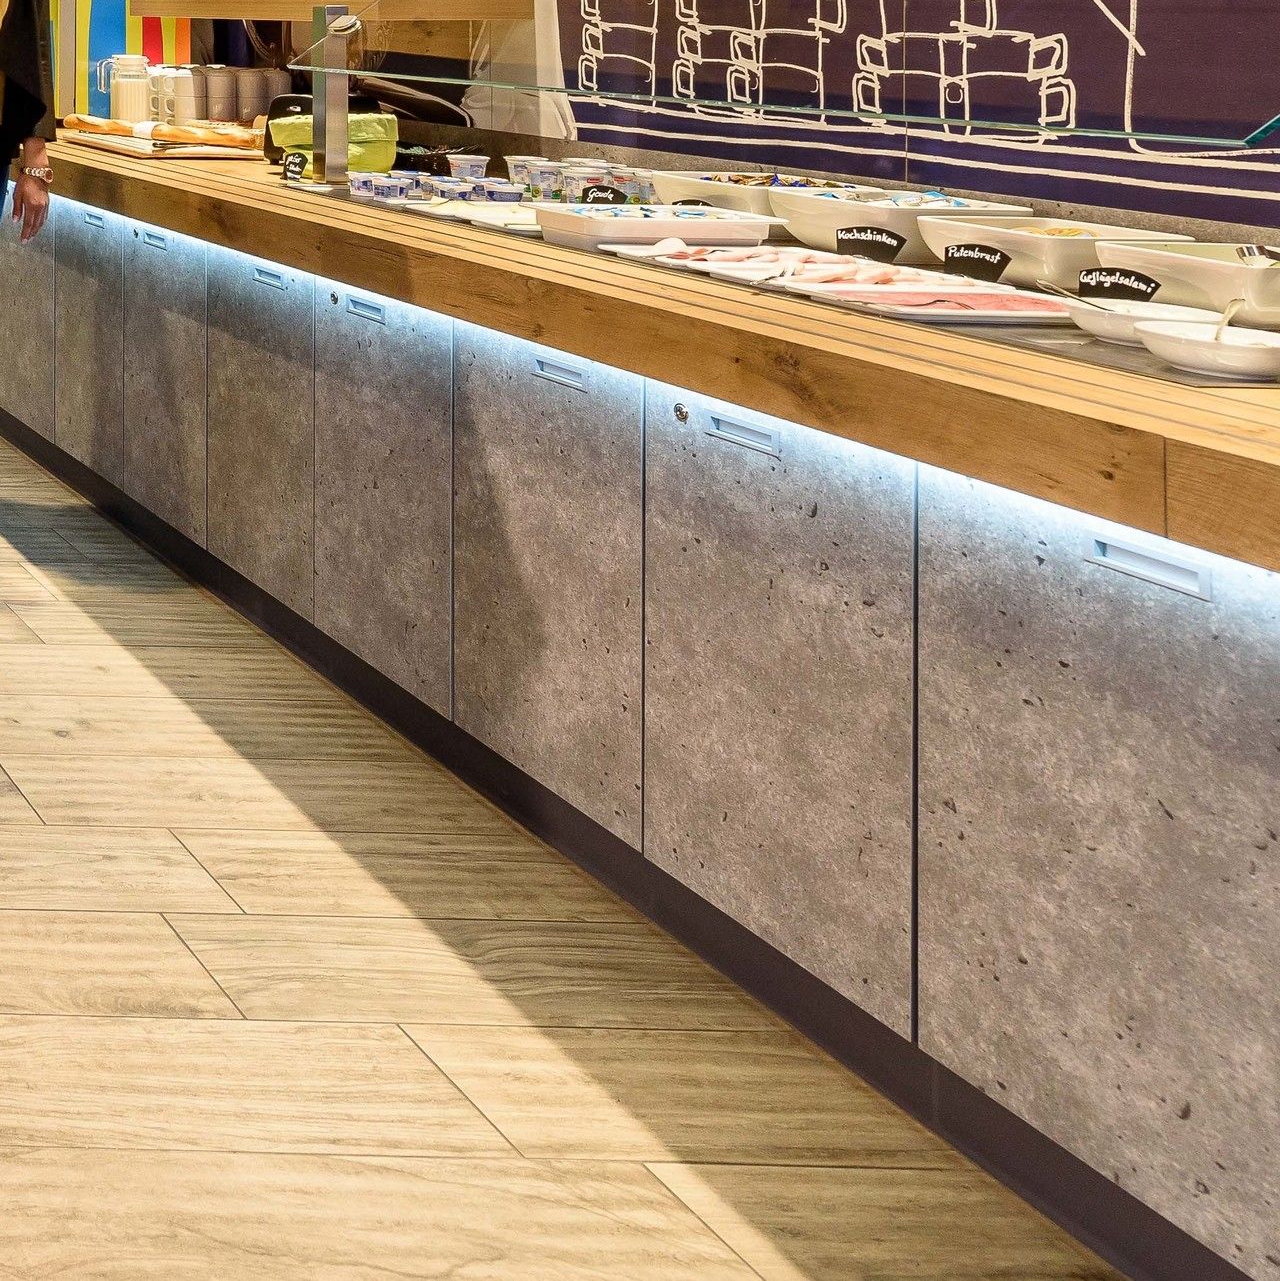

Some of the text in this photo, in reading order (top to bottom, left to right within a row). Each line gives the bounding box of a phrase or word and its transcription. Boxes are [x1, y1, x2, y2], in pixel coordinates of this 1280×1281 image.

[587, 188, 614, 202] Gouda
[837, 229, 898, 247] Kochschinken
[948, 246, 1001, 263] Putenbrust
[1080, 271, 1156, 293] Geflügelsalami
